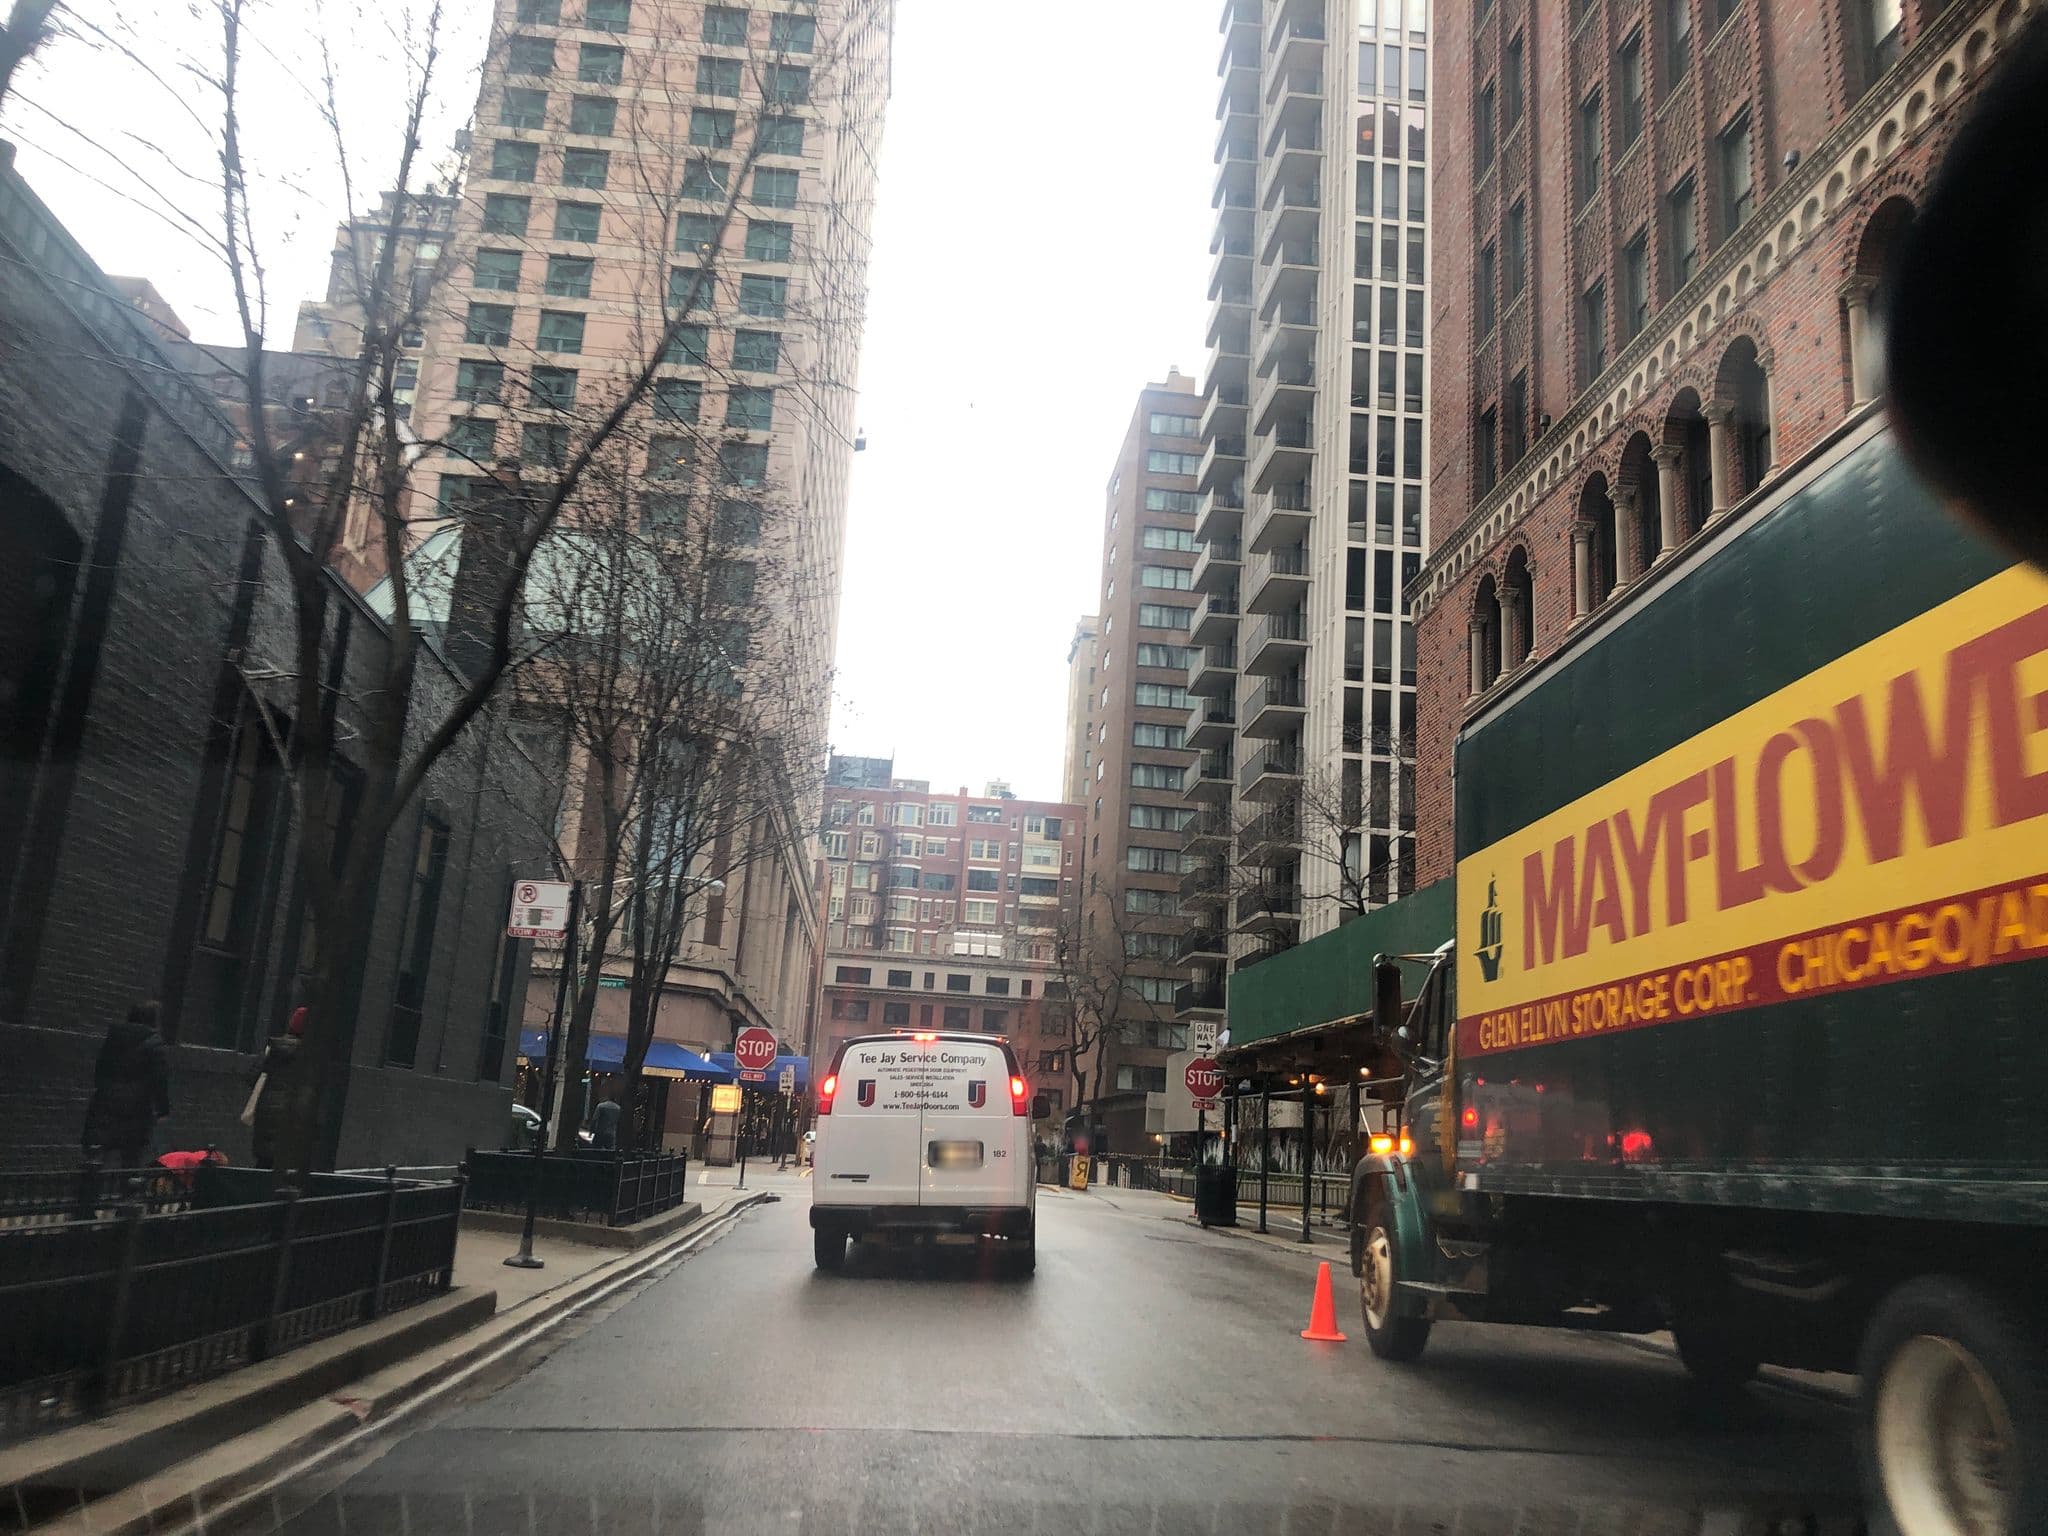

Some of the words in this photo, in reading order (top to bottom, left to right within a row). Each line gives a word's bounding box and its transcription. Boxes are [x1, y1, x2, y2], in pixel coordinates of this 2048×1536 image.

[535, 929, 561, 937] ZONE
[1479, 1013, 1518, 1050] GLEN
[1520, 1000, 1569, 1043] ELLYN
[1571, 974, 1670, 1035] STORAGE
[1673, 955, 1758, 1015] CORP.
[1197, 1024, 1215, 1033] ONE
[1197, 1033, 1215, 1041] WAY
[738, 1040, 775, 1057] STOP
[859, 1053, 877, 1064] Tee
[880, 1053, 897, 1065] Jay
[900, 1052, 937, 1063] Service
[940, 1052, 987, 1066] Company
[1187, 1069, 1222, 1087] STOP
